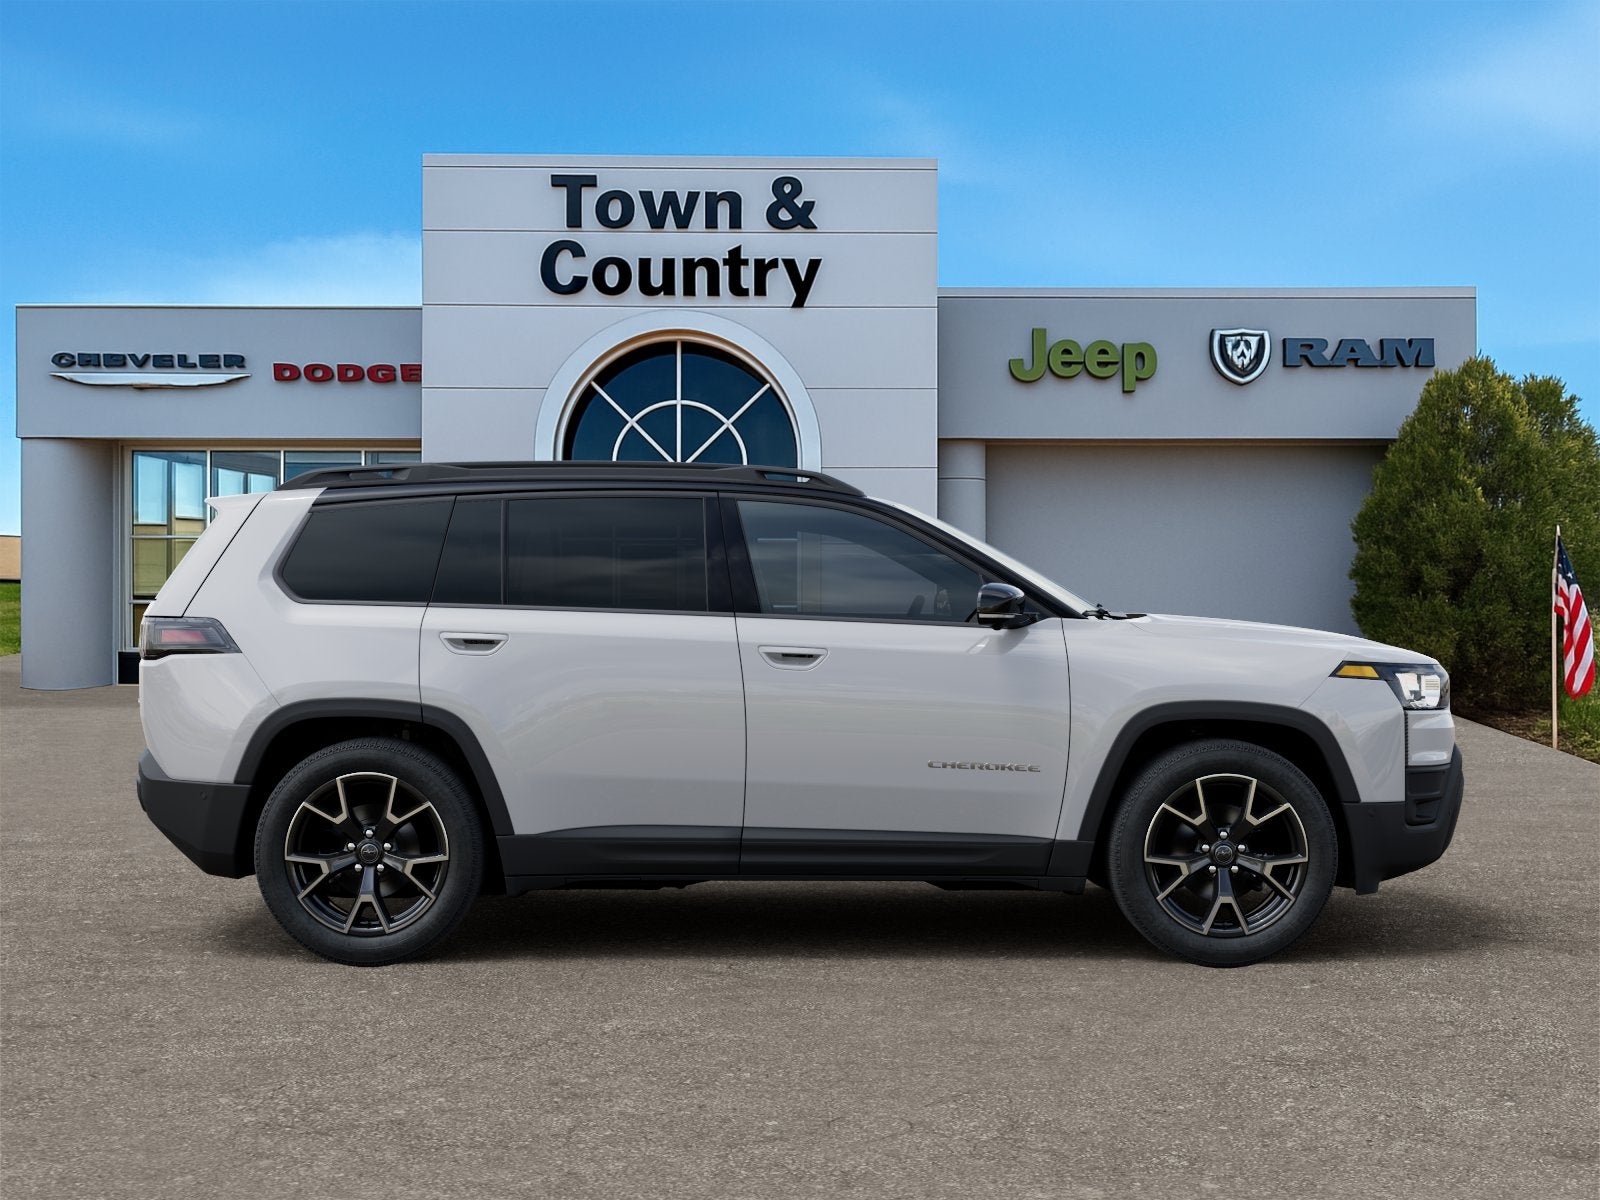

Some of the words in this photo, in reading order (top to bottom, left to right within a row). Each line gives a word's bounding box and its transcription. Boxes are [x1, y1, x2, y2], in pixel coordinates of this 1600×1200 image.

[550, 174, 742, 229] Town
[765, 175, 818, 230] &
[540, 239, 822, 308] Country
[272, 362, 422, 383] DODGE
[1008, 327, 1158, 393] Jeep
[1282, 337, 1436, 368] RAM
[927, 760, 1041, 773] CHEROKEE
